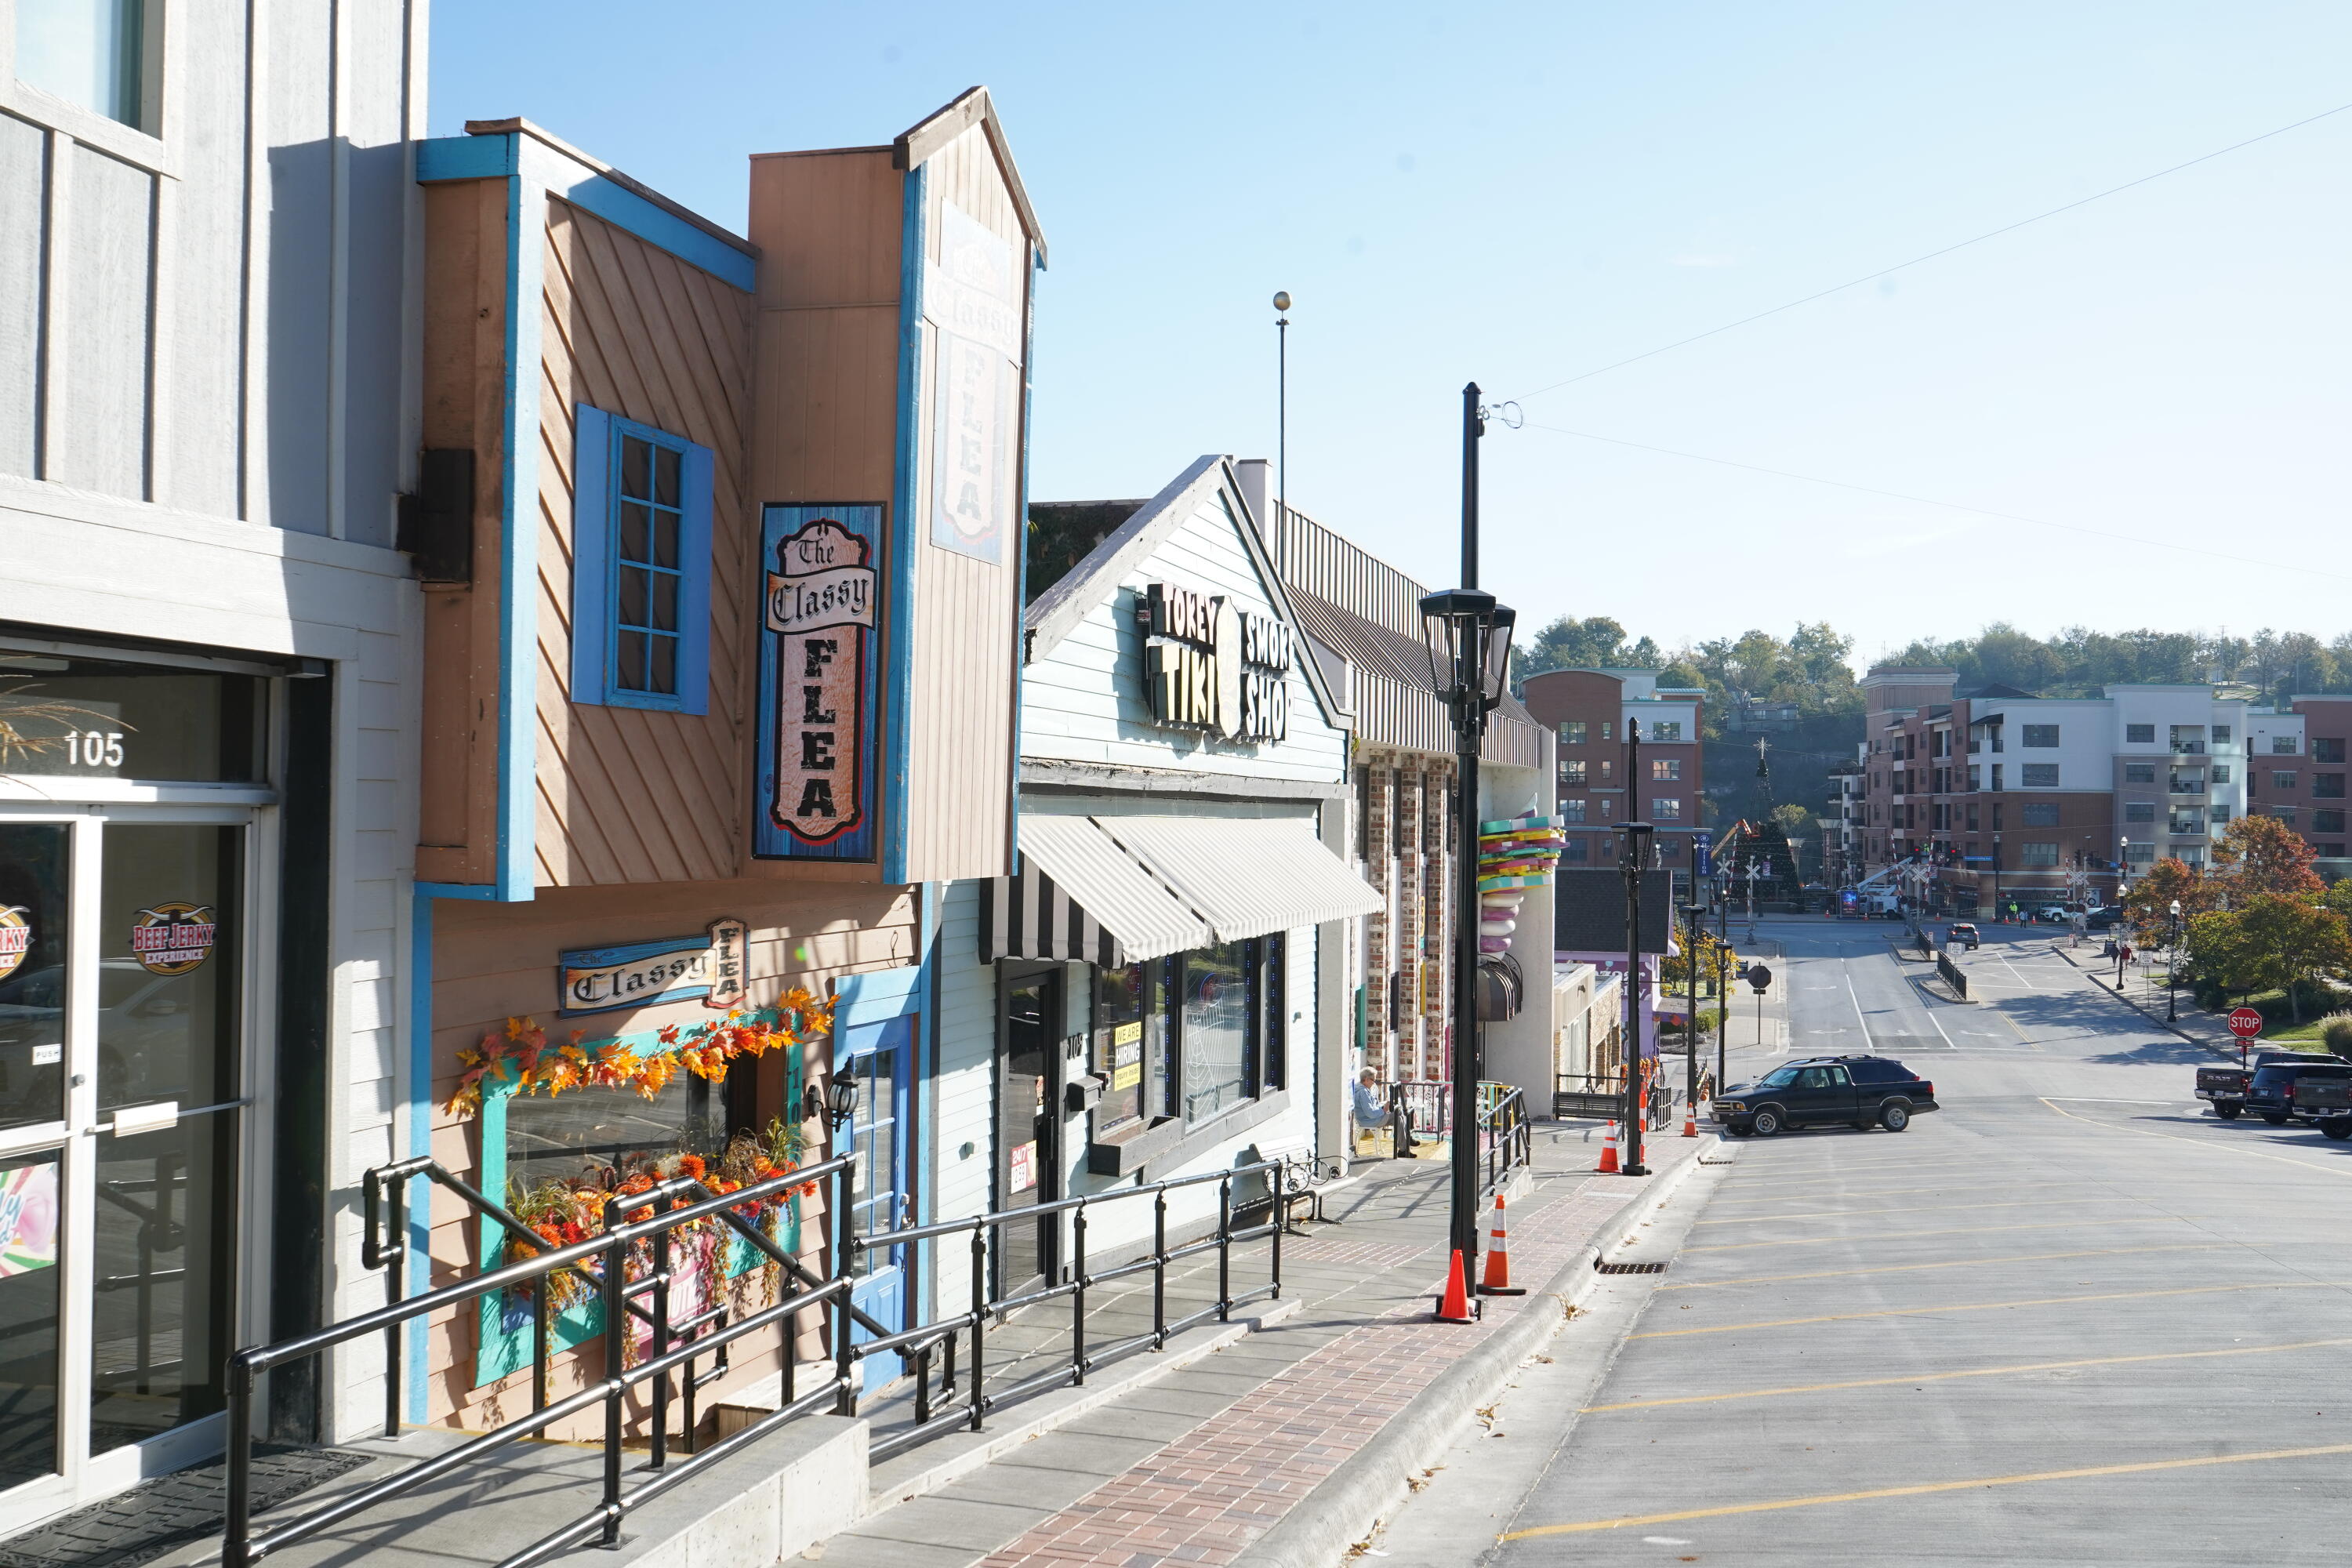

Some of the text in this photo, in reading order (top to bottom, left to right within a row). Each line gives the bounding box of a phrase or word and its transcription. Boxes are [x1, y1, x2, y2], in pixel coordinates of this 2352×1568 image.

[929, 282, 1018, 347] Classy
[956, 348, 986, 521] FLEA
[796, 538, 834, 565] The
[771, 575, 870, 626] Classy
[1160, 583, 1217, 645] TOKEY
[1246, 612, 1295, 672] SMOKE
[1161, 641, 1215, 725] TIKI
[1246, 672, 1294, 741] SHOP
[64, 731, 124, 767] 105
[797, 639, 838, 818] FLEA
[132, 923, 216, 952] BEEF JERKY
[145, 949, 205, 965] EXPERIENCE
[579, 953, 604, 965] The
[716, 927, 741, 996] FLEA
[573, 956, 710, 1004] Classy
[1116, 1025, 1140, 1042] WE ARE
[2230, 1017, 2259, 1029] STOP
[1116, 1042, 1141, 1067] HIRING
